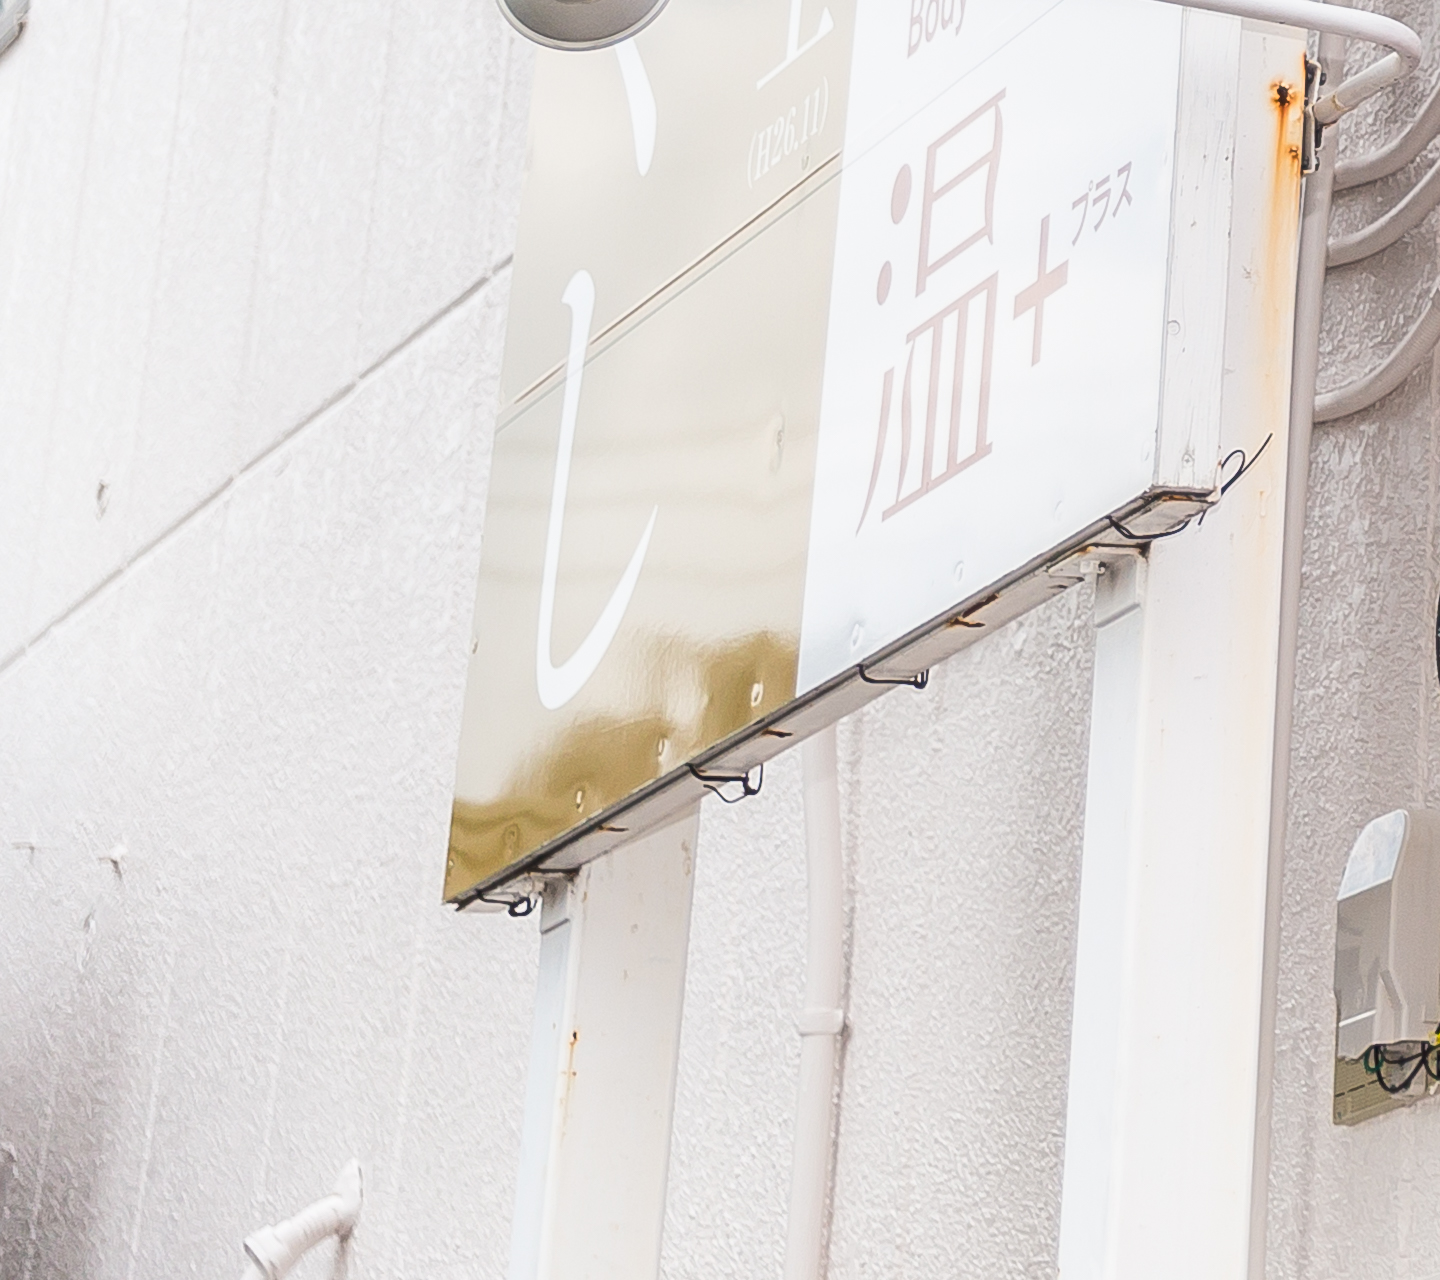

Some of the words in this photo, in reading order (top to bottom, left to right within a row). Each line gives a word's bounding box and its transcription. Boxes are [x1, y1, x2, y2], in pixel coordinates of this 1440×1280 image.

[747, 76, 829, 190] (H26.11)
[1071, 160, 1133, 248] プラス
